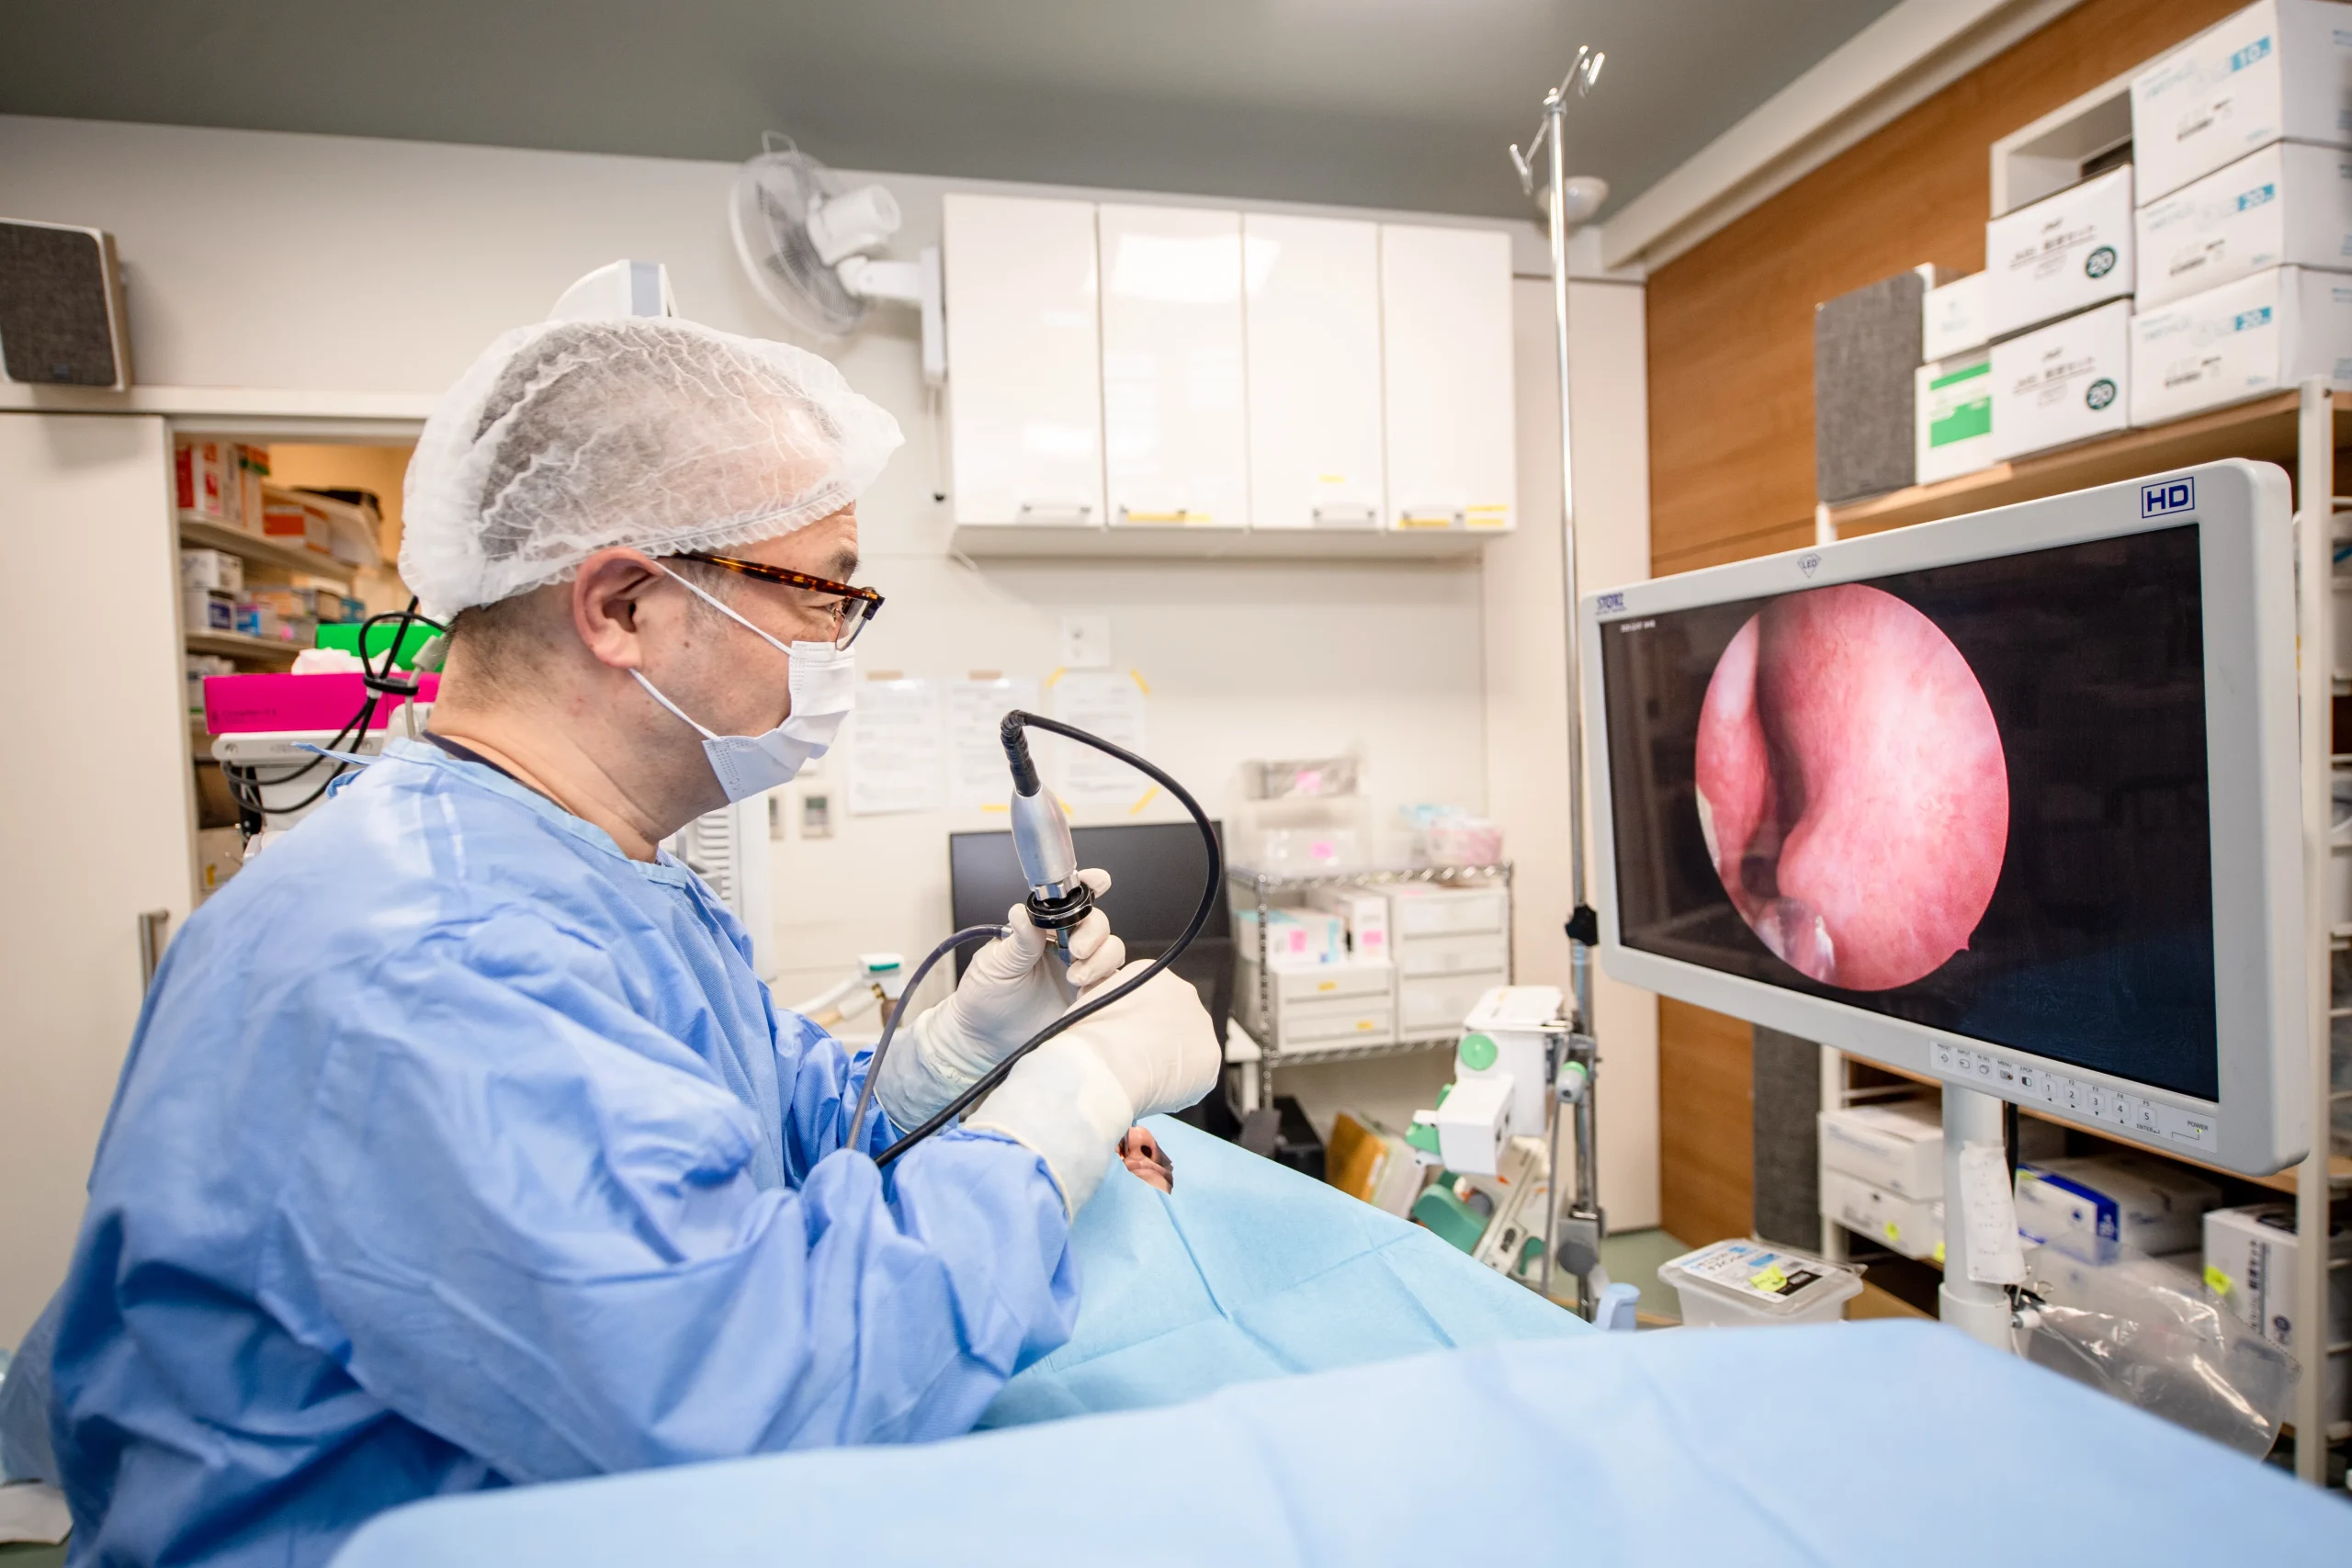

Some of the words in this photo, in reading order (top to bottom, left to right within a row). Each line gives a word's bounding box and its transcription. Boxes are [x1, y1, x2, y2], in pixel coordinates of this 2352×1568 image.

[2087, 249, 2113, 276] 20
[2087, 382, 2113, 409] 20
[2147, 484, 2188, 513] HD
[1804, 558, 1817, 569] LED
[1997, 1060, 2012, 1068] MENU
[2136, 1123, 2154, 1133] ENTER
[2187, 1120, 2209, 1131] POWER
